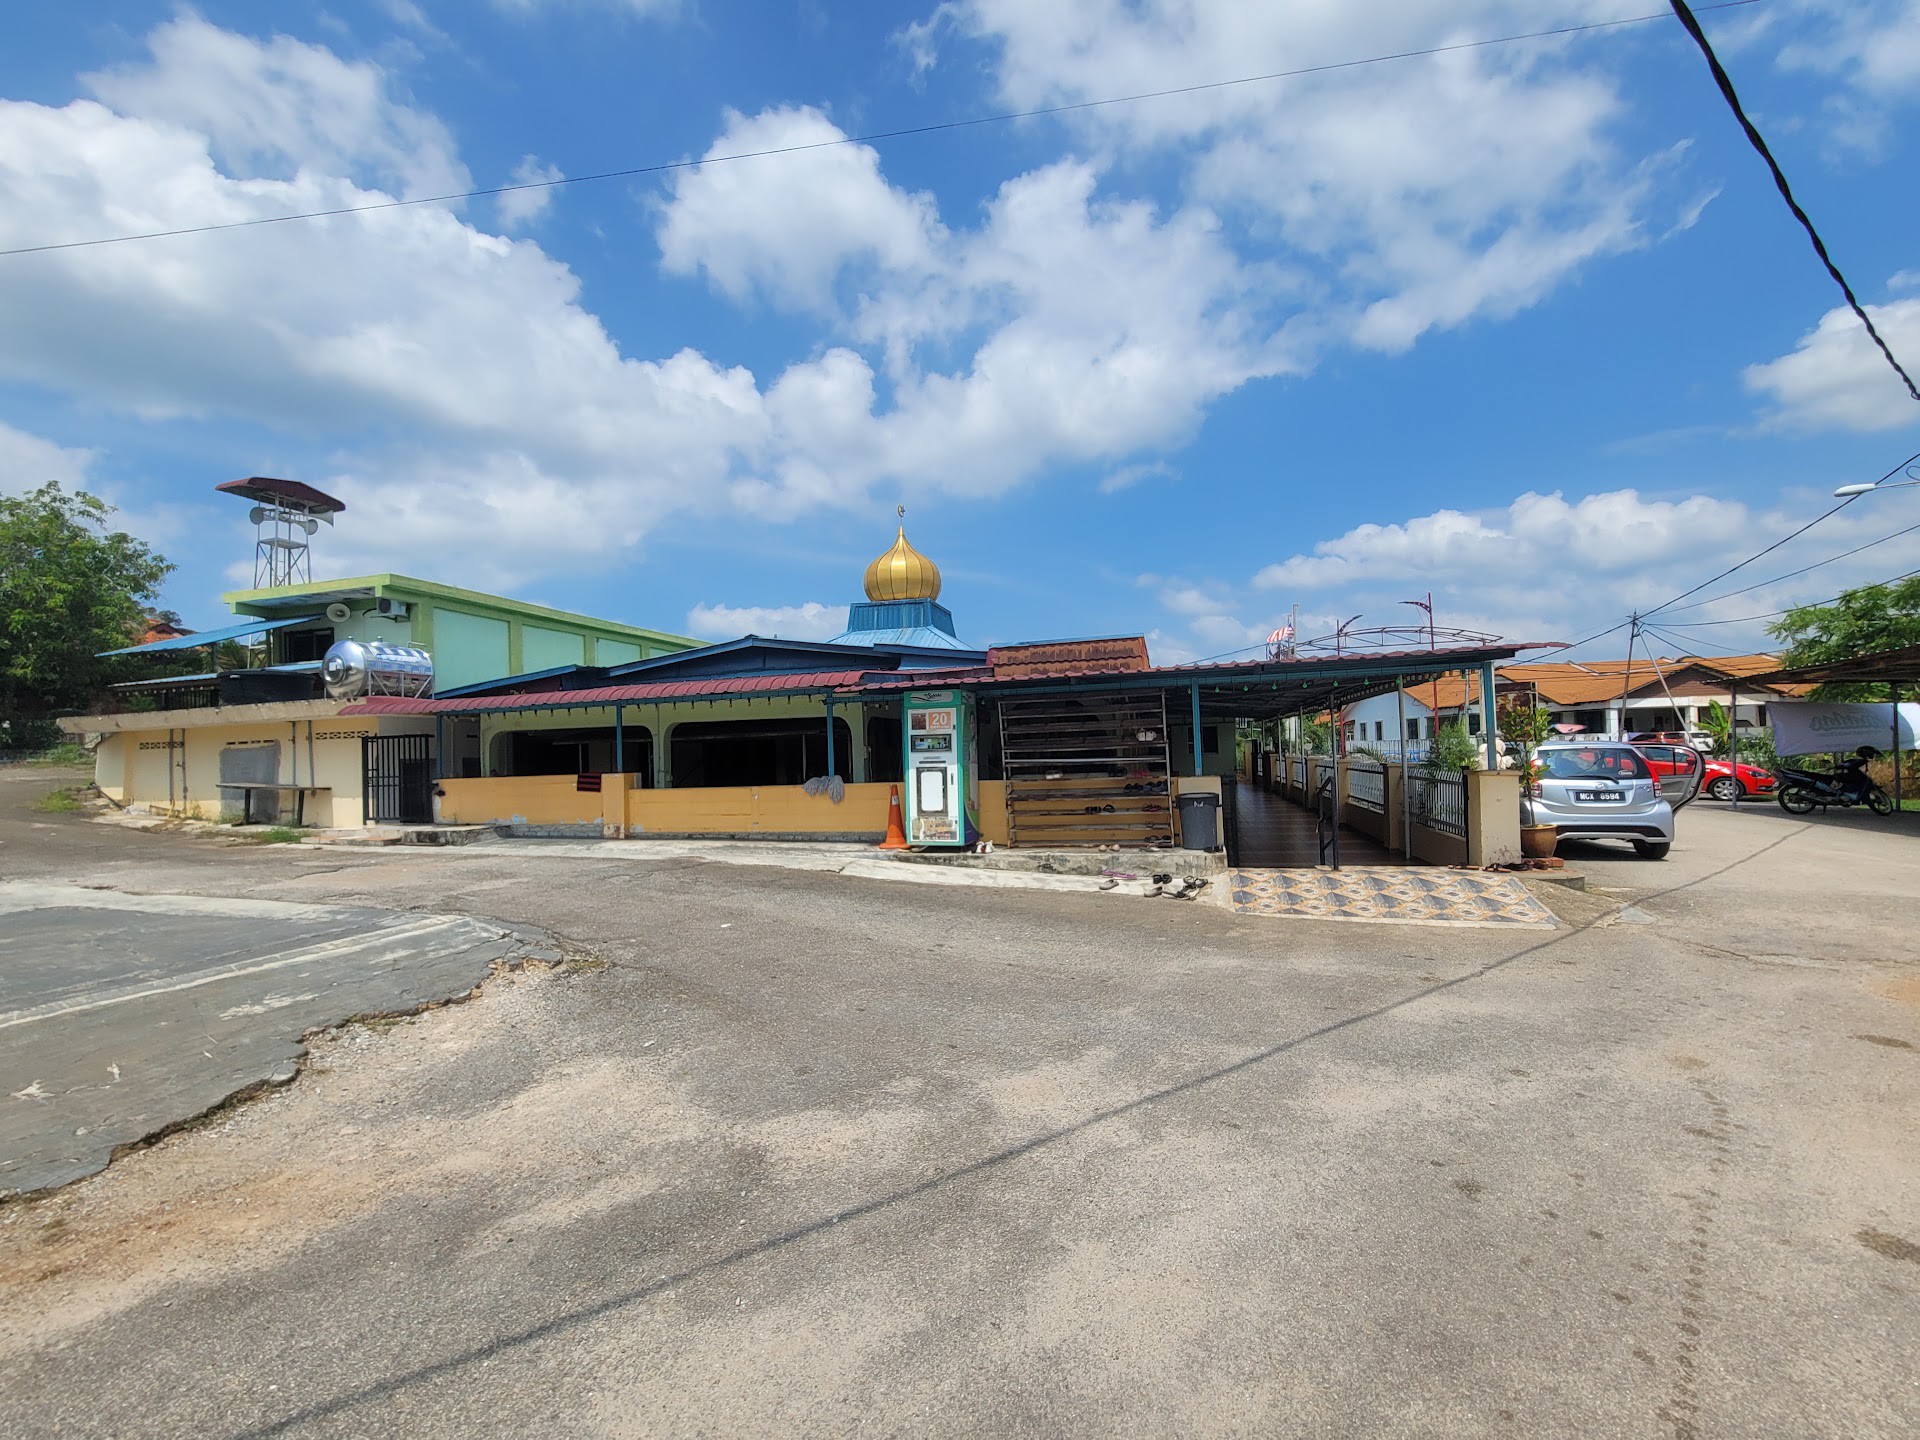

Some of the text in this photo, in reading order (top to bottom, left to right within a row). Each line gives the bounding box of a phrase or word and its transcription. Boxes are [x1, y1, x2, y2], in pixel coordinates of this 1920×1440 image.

[932, 713, 948, 725] 20
[1579, 792, 1620, 800] MCX 8594
